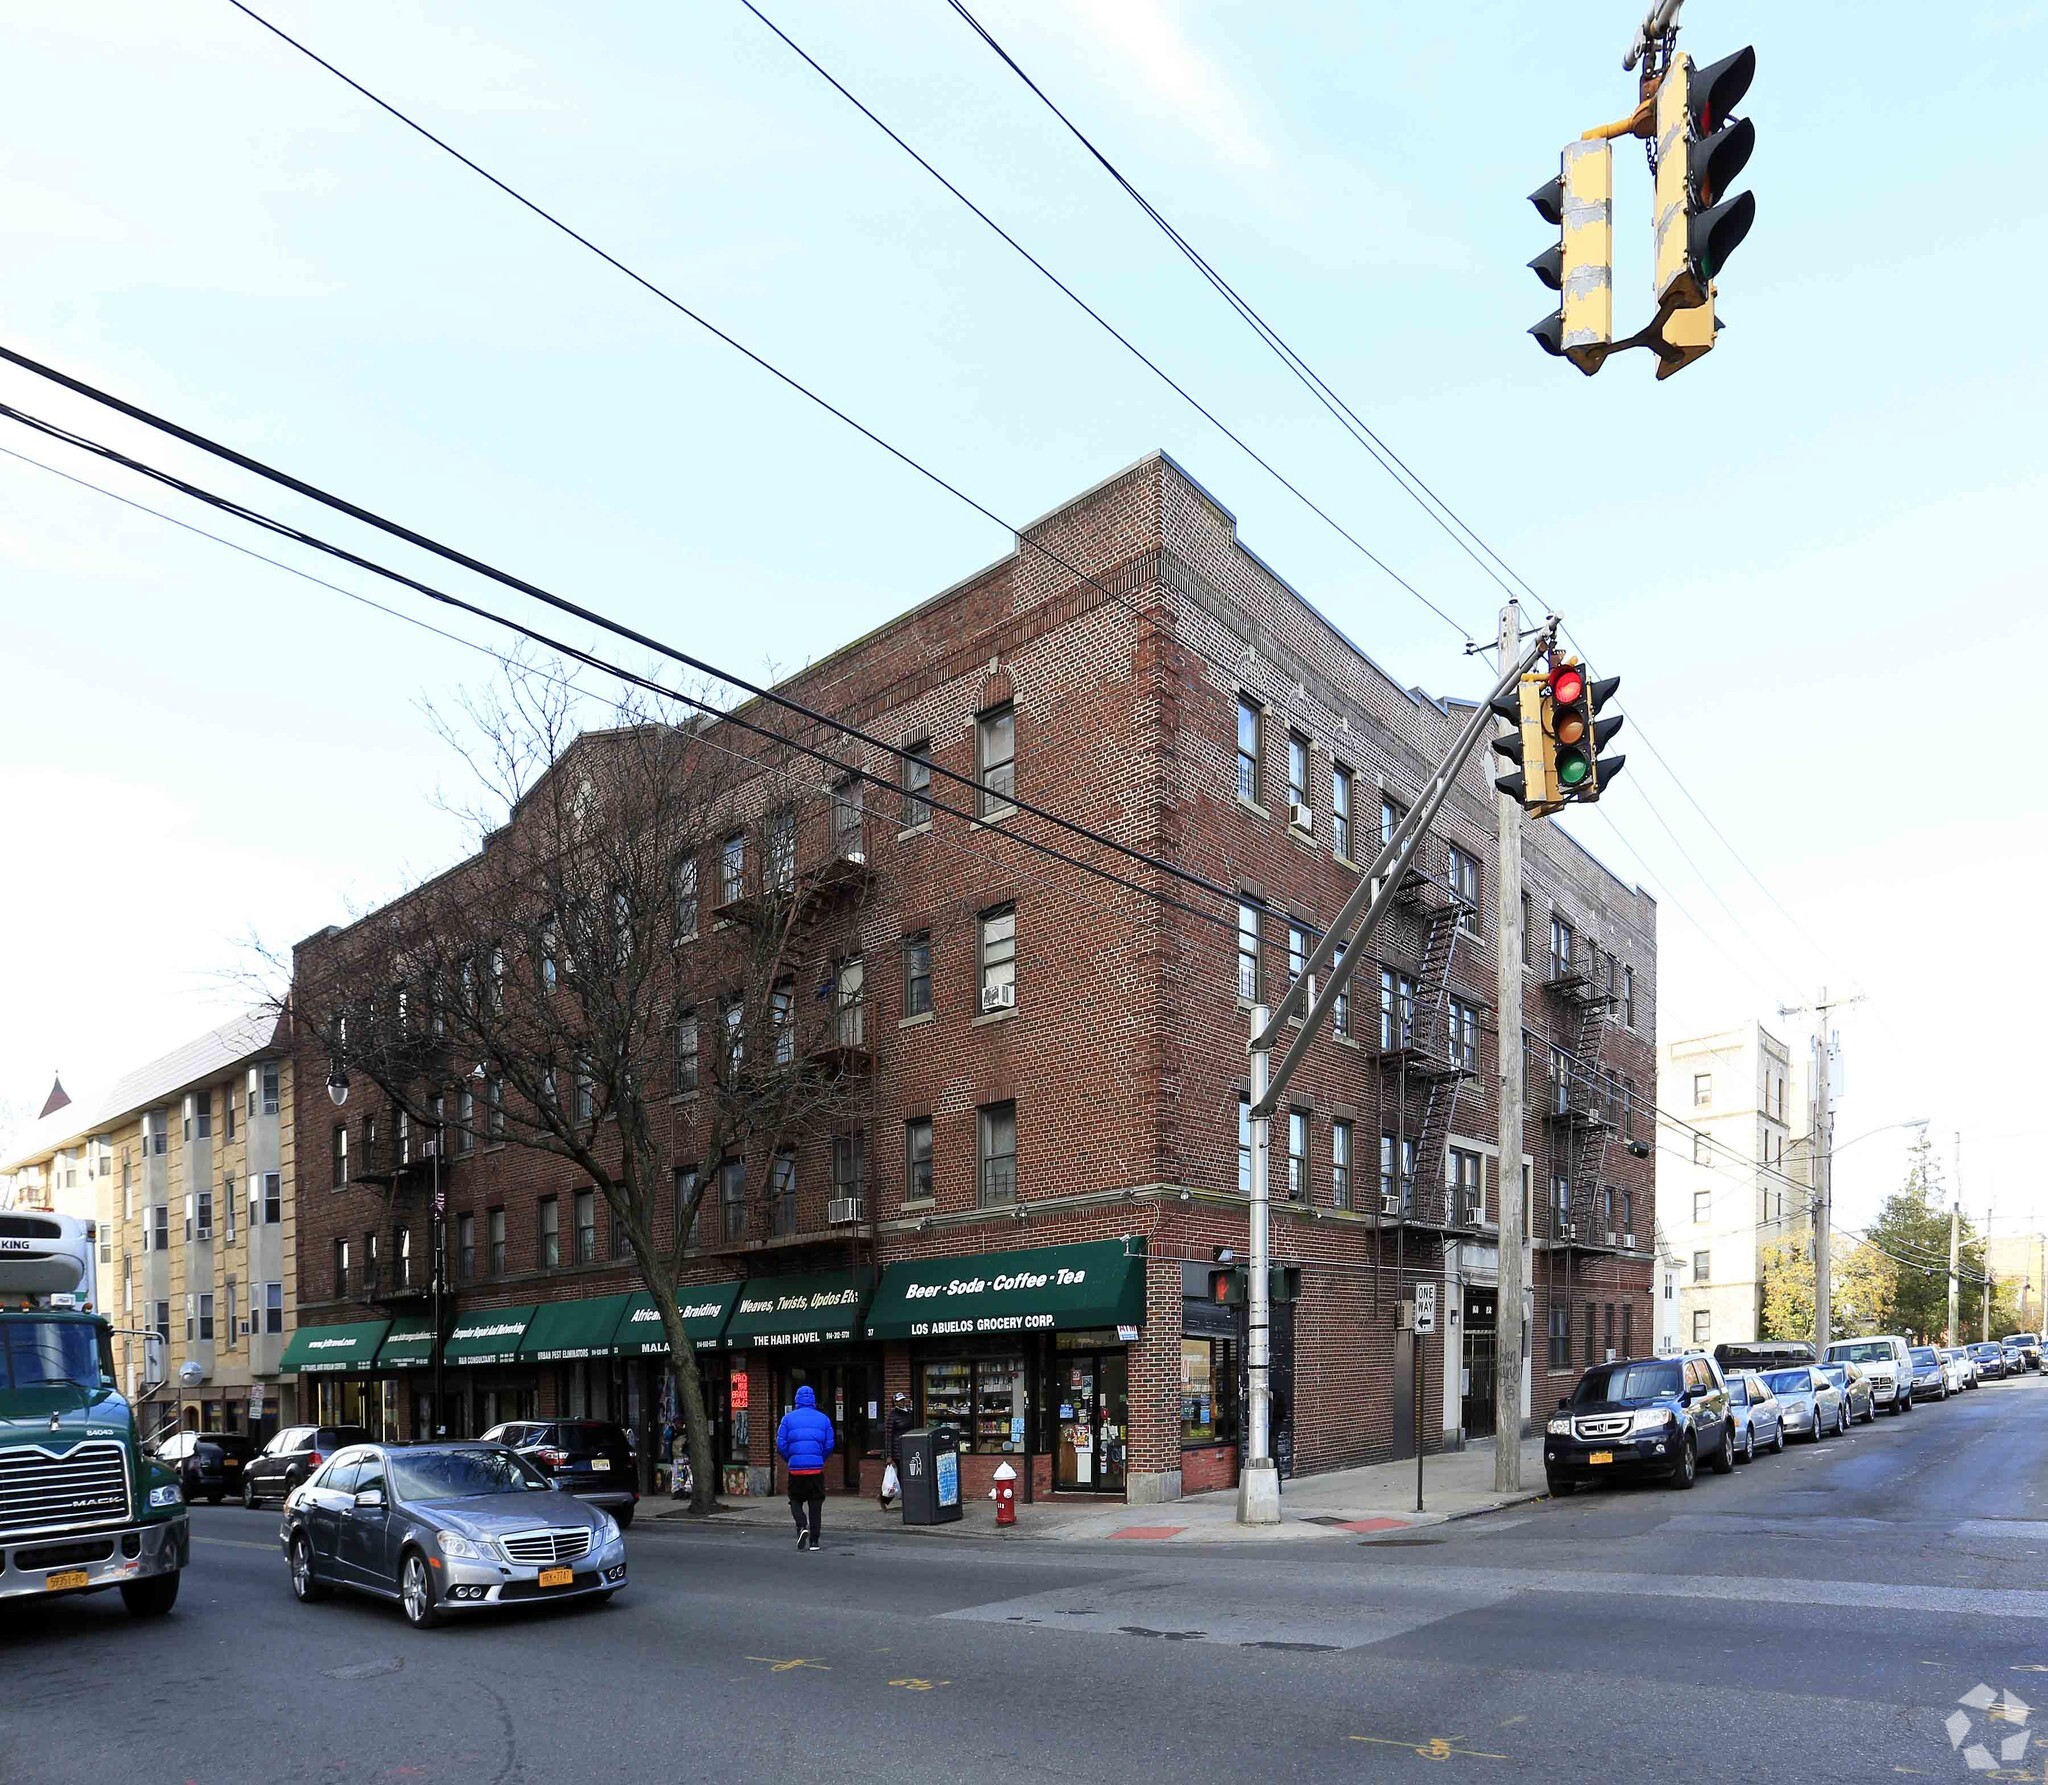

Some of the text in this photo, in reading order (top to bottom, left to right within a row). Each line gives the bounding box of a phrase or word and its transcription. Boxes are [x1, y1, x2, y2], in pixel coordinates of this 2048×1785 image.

[1, 1240, 30, 1250] KING
[1418, 1287, 1434, 1299] ONE
[739, 1299, 774, 1314] Weaves,
[810, 1291, 841, 1309] Updos
[1418, 1301, 1434, 1313] WAY
[681, 1303, 722, 1318] Braiding
[911, 1314, 1055, 1336] LOS ABUELOS GROCERY CORP.
[867, 1328, 875, 1337] 37
[753, 1336, 769, 1346] THE
[770, 1333, 791, 1345] HAIR
[792, 1332, 821, 1344] HOVEL
[72, 1497, 120, 1508] MACK
